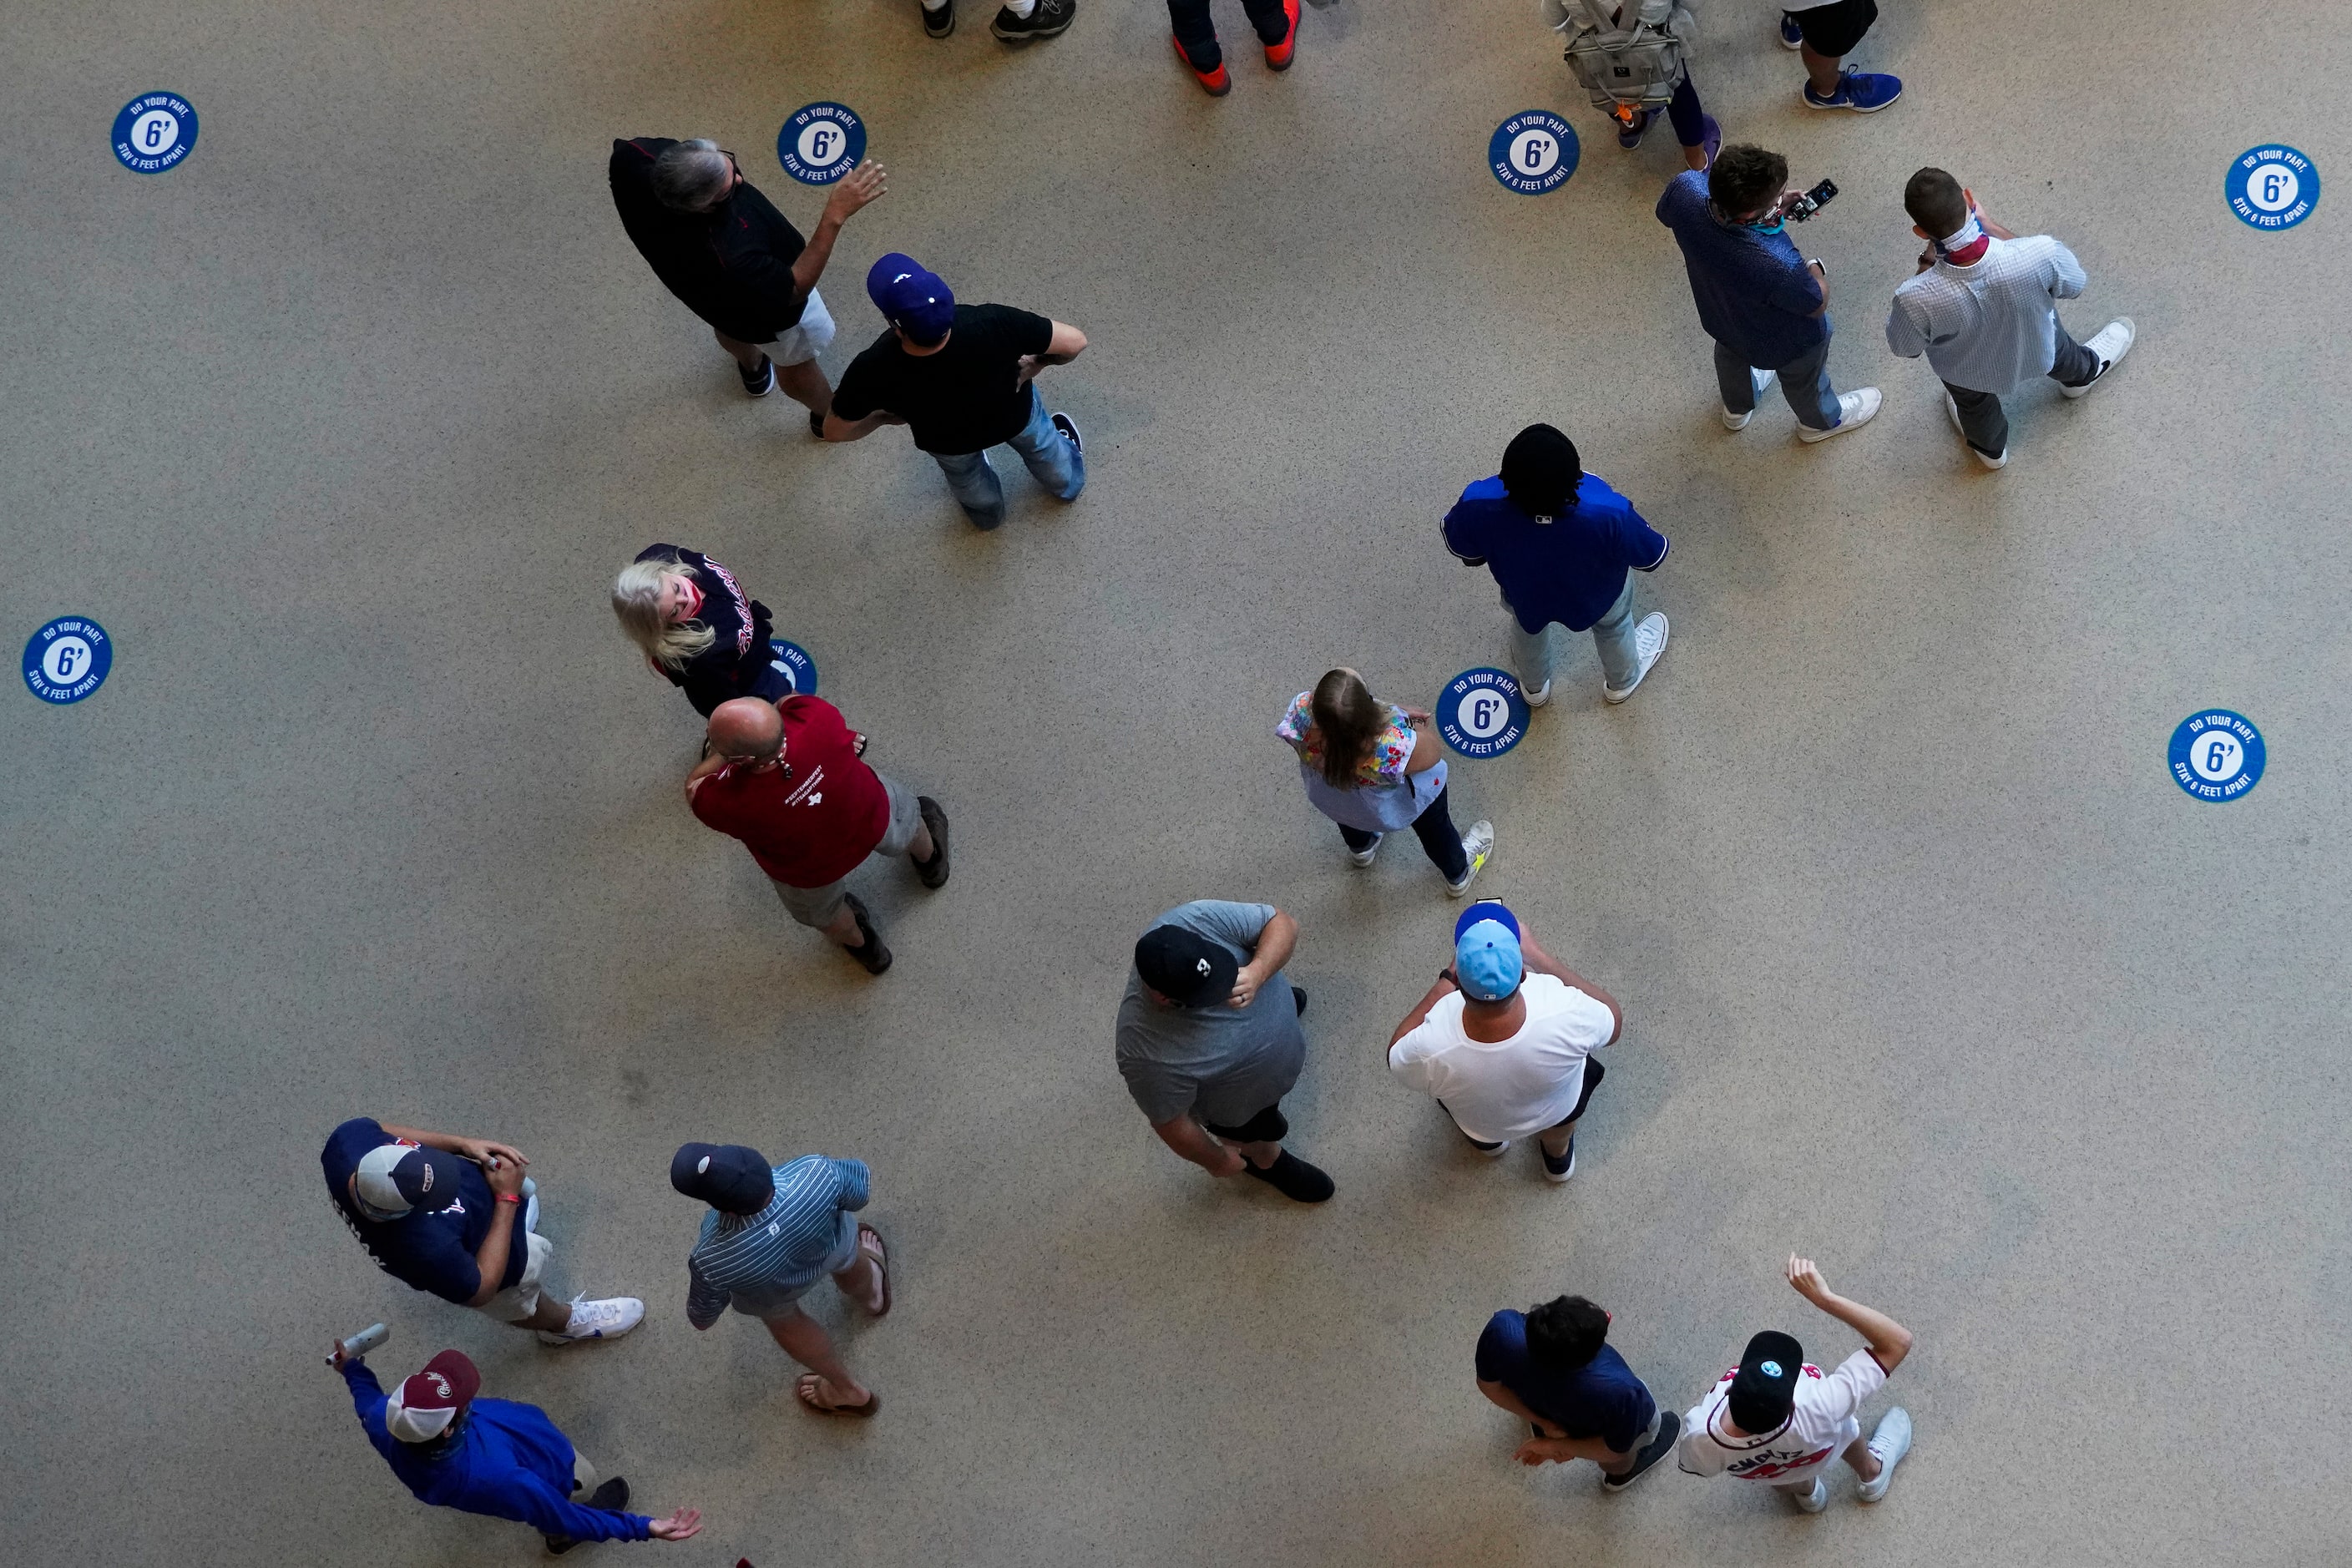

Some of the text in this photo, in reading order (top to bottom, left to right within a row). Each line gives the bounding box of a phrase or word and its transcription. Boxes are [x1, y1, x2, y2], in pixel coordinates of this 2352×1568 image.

[130, 97, 189, 118] DO YOUR PART,
[797, 108, 857, 129] DO YOUR PART,
[1506, 116, 1569, 138] DO YOUR PART,
[118, 143, 134, 160] STAY
[139, 159, 159, 169] FEET
[163, 144, 186, 165] APART
[785, 154, 801, 171] STAY
[807, 171, 827, 180] FEET
[831, 156, 854, 178] APART
[2243, 150, 2308, 173] DO YOUR PART,
[1496, 163, 1513, 180] STAY
[1520, 180, 1540, 190] FEET
[1545, 165, 1568, 187] APART
[2233, 197, 2309, 225] STAY 6 FEET APART
[43, 622, 104, 645] DO YOUR PART,
[786, 648, 807, 669] PART,
[29, 670, 99, 699] STAY 6 FEET APART
[1454, 674, 1518, 696] DO YOUR PART,
[1444, 725, 1520, 753] STAY 6 FEET APART
[2189, 716, 2255, 743] DO YOUR PART,
[2175, 762, 2251, 797] STAY 6 FEET APART
[1727, 1449, 1803, 1472] SMOLTZ
